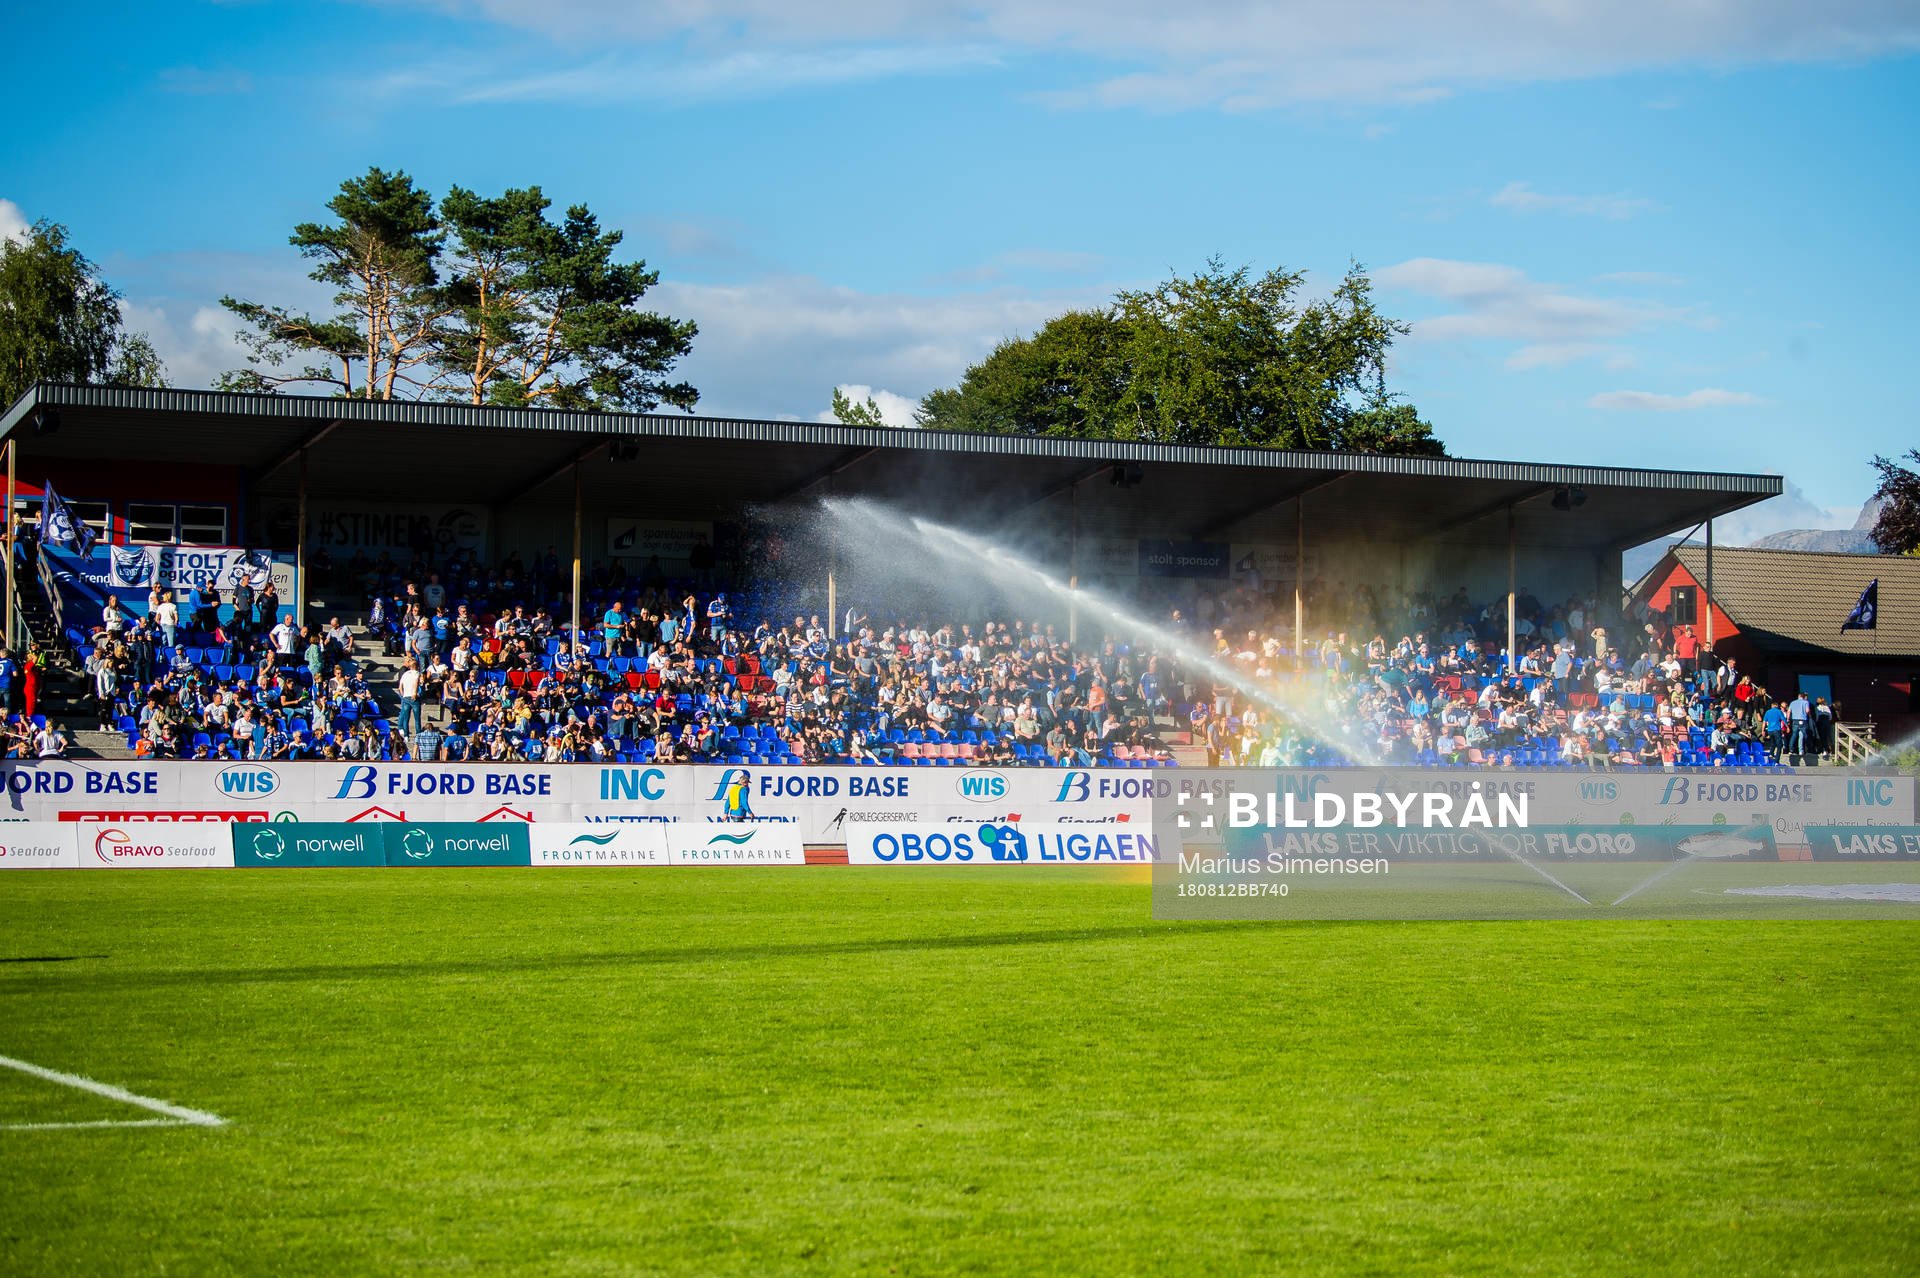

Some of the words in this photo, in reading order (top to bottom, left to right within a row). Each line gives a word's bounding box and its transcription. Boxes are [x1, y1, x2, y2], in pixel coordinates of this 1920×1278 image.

[160, 553, 227, 569] STOLT
[1149, 553, 1173, 565] stolt
[1176, 557, 1221, 569] sponsor
[79, 573, 110, 584] Frend
[159, 570, 177, 581] og
[85, 771, 158, 794] BASE
[222, 772, 275, 793] WIS
[388, 773, 475, 796] FJORD
[486, 773, 551, 795] BASE
[600, 769, 666, 800] INC
[760, 775, 839, 797] FJORD
[849, 776, 909, 797] BASE
[962, 777, 1005, 796] WIS
[1099, 778, 1172, 799] FJORD
[1180, 779, 1236, 799] BASE
[1485, 781, 1535, 800] BASE
[1580, 782, 1617, 800] WIS
[1697, 783, 1759, 802] FJORD
[1766, 784, 1813, 802] BASE
[1847, 779, 1894, 806] INC
[850, 812, 918, 822] RØRLEGGERSERVICE
[10, 846, 61, 857] Seafood
[113, 846, 164, 857] BRAVO
[167, 846, 216, 857] Seafood
[296, 835, 364, 852] norwell
[445, 834, 510, 851] norwell
[872, 832, 974, 861] OBOS
[1037, 833, 1161, 861] LIGAEN
[1263, 832, 1341, 855] LAKS
[1345, 833, 1379, 854] ER
[1385, 833, 1478, 855] VIKTIG
[1488, 833, 1540, 854] FOR
[1544, 831, 1636, 855] FLORØ
[1831, 834, 1898, 854] LAKS
[543, 850, 656, 860] FRONTMARINE
[683, 849, 792, 860] FRONTMARINE
